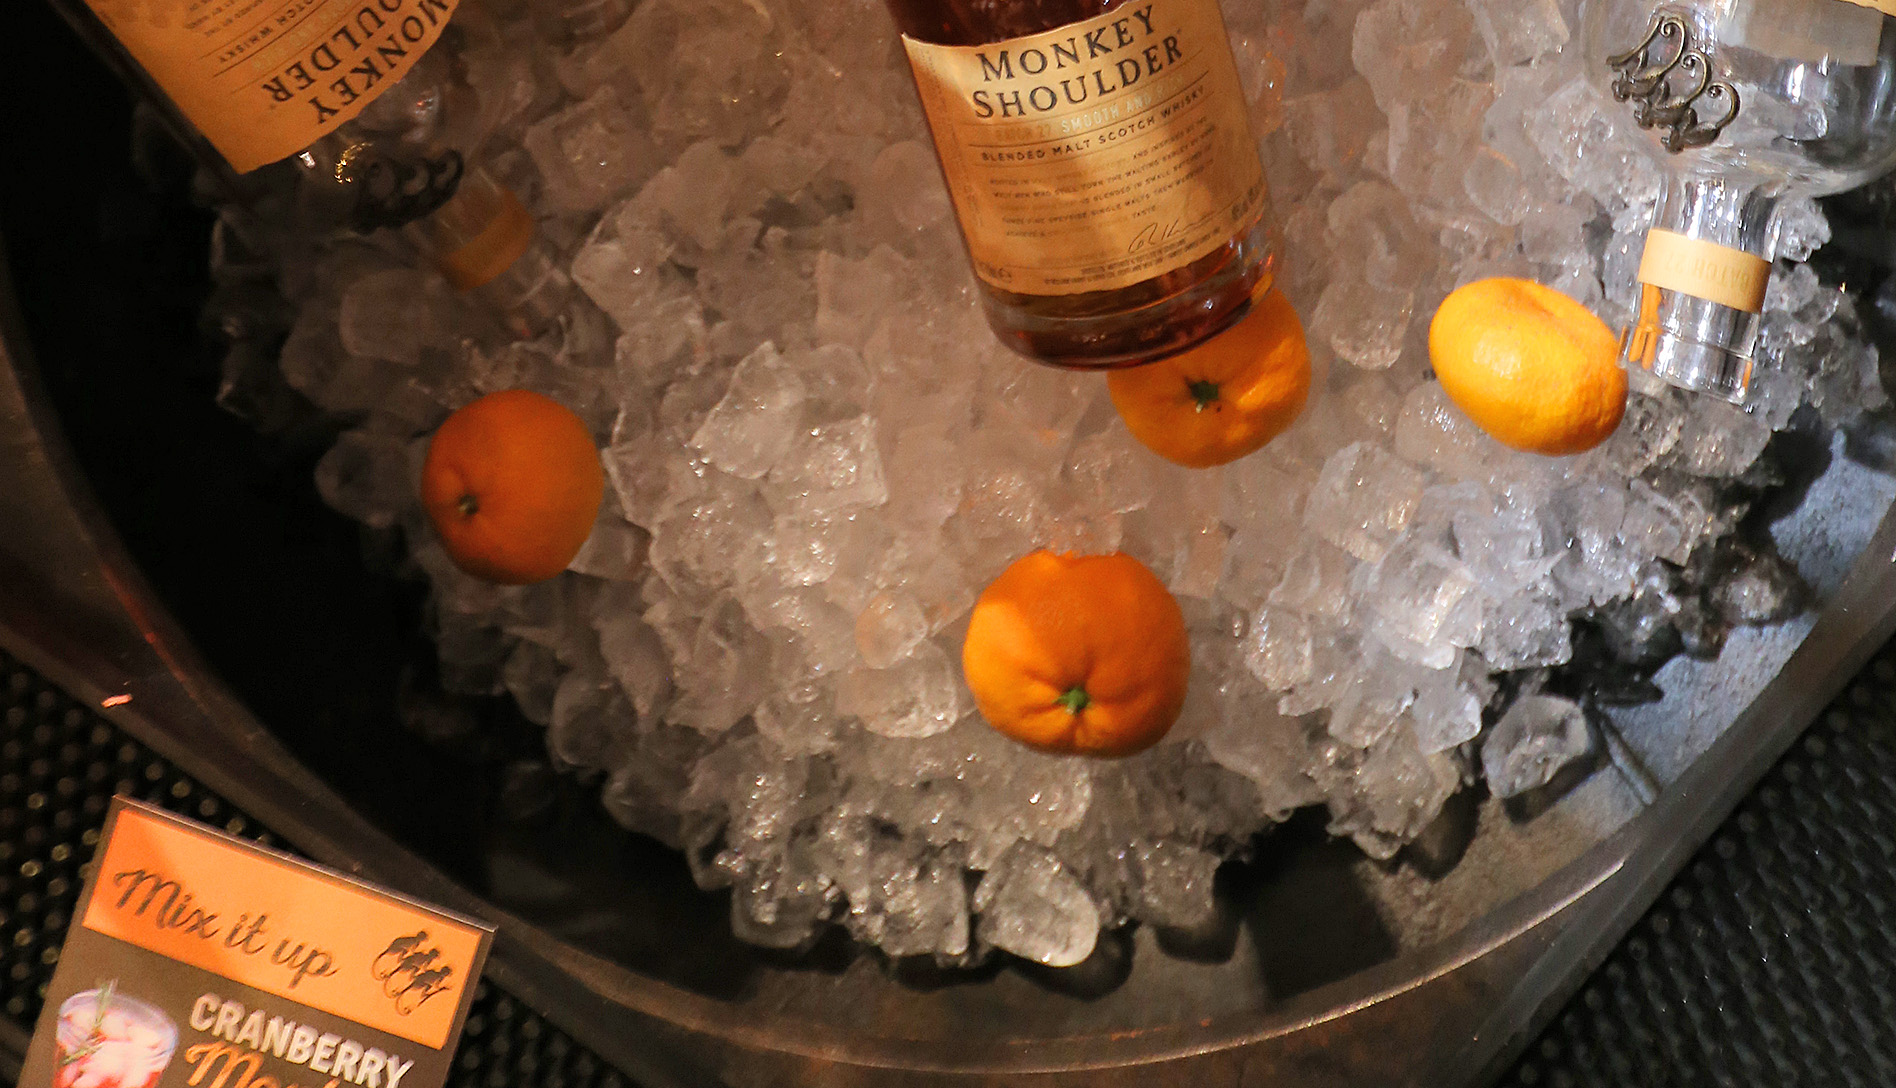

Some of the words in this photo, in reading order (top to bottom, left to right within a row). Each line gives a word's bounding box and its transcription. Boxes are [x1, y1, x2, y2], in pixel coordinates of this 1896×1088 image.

[219, 26, 273, 63] WHISKY
[975, 4, 1152, 82] MONKEY
[975, 34, 1183, 118] SHOULDER
[981, 149, 1046, 161] BLENDED
[1051, 139, 1090, 156] MALT
[1098, 115, 1155, 144] SCOTCH
[1160, 85, 1203, 118] WHISKY
[1061, 107, 1119, 132] SMOOTH
[1124, 95, 1151, 112] AND
[113, 868, 219, 941] Mix
[223, 912, 268, 955] it
[271, 939, 340, 989] up
[190, 995, 413, 1088] CRANBERRY
